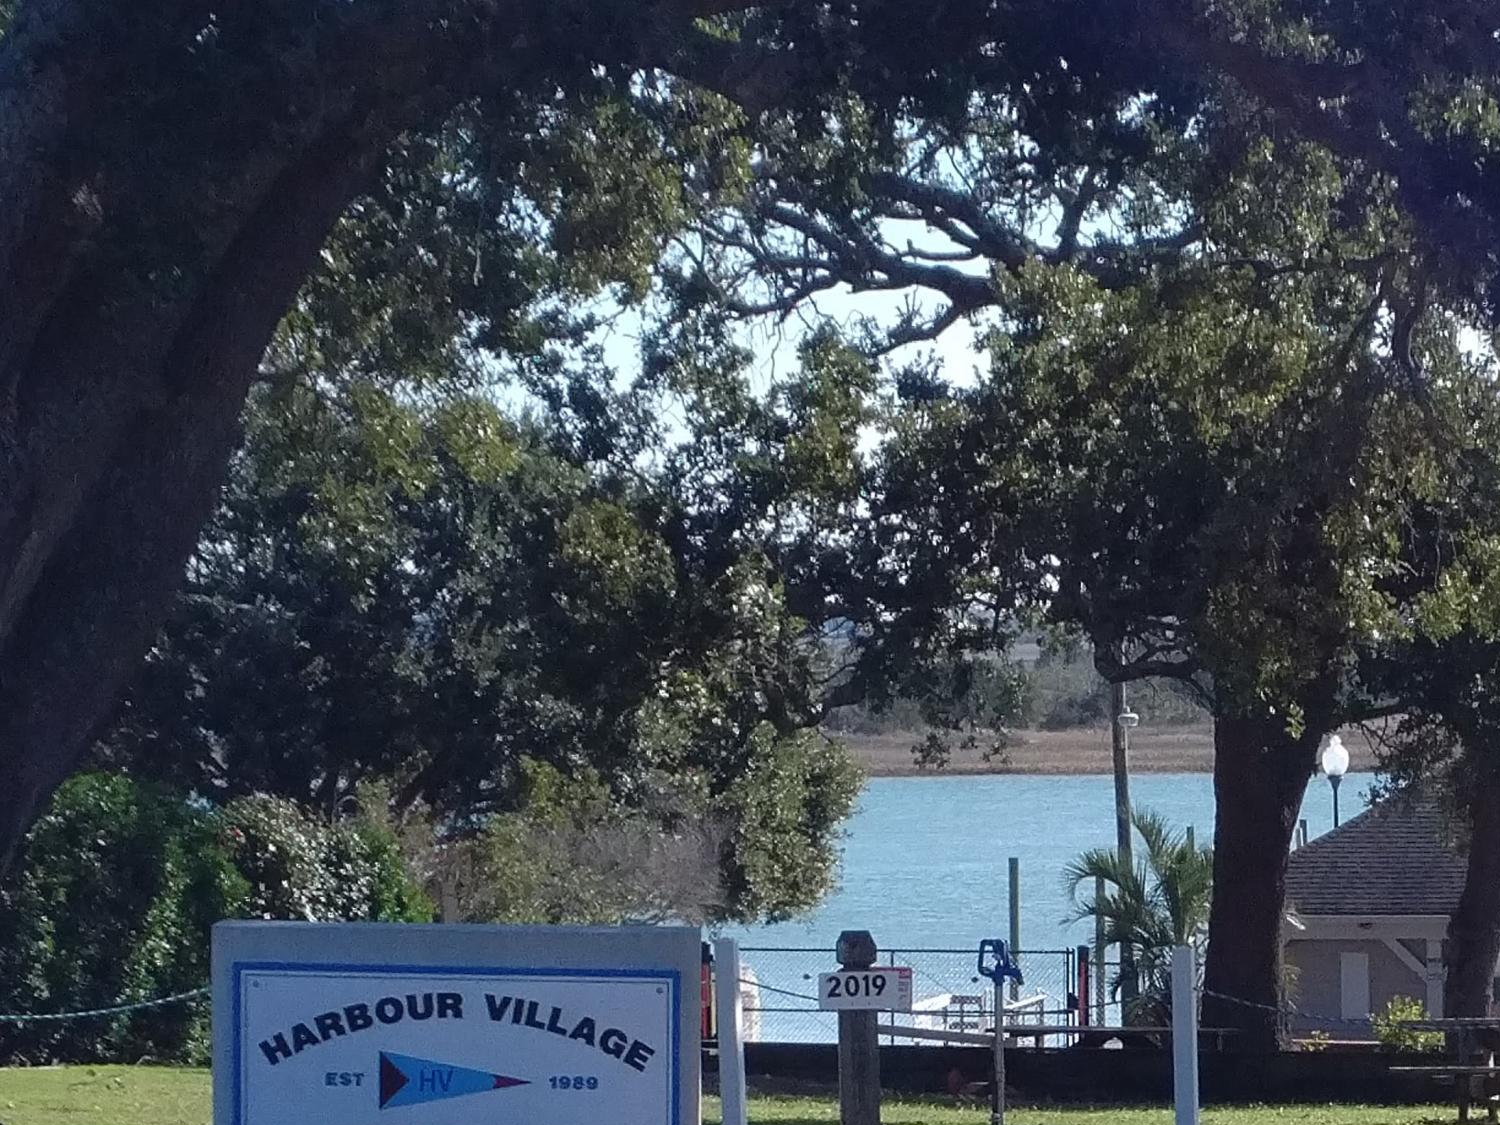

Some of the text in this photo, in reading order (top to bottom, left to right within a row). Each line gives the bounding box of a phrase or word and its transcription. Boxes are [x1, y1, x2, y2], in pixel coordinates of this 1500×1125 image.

[826, 974, 887, 998] 2019
[258, 993, 656, 1073] HARBOUR VILLAGE
[324, 1071, 365, 1087] EST
[419, 1069, 454, 1092] HV
[549, 1075, 599, 1090] 1989
